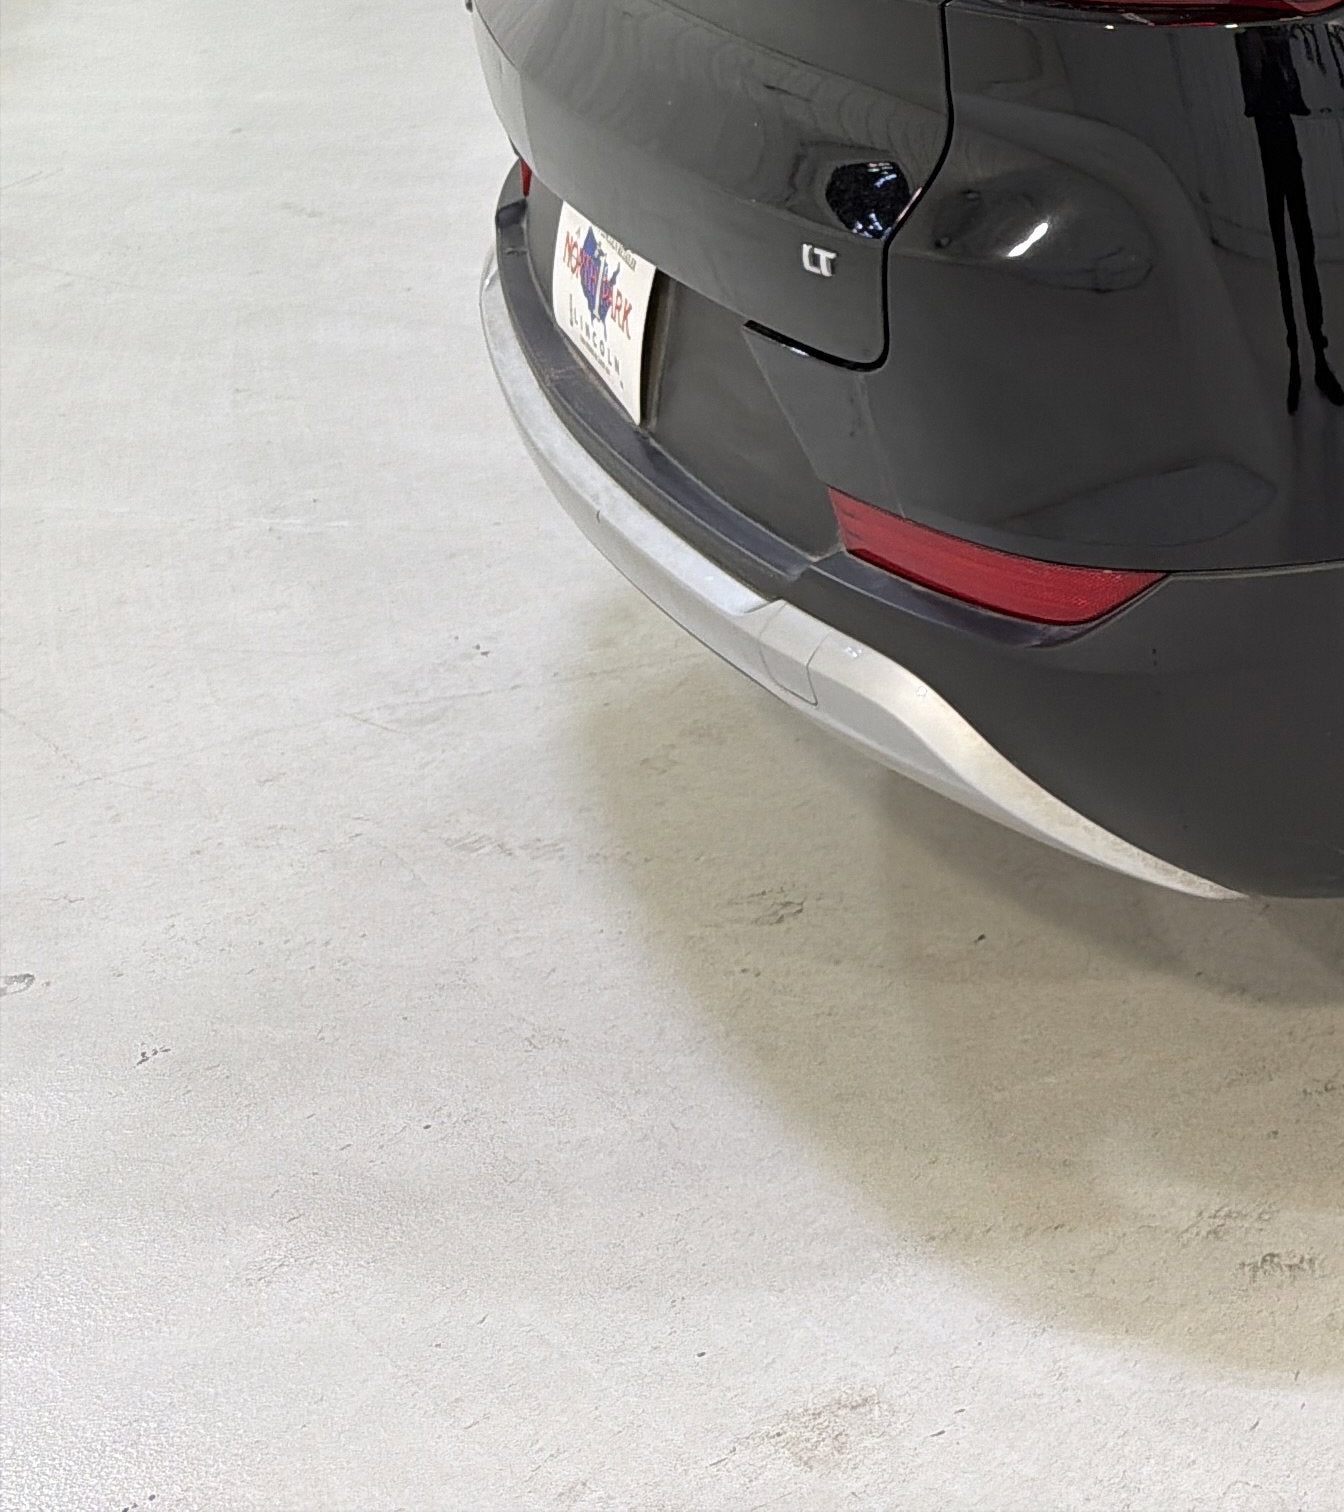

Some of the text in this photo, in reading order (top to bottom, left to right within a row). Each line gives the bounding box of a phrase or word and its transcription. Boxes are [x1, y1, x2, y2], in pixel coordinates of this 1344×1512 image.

[563, 230, 597, 296] NORTH
[600, 276, 632, 340] PARK
[802, 243, 837, 277] LT
